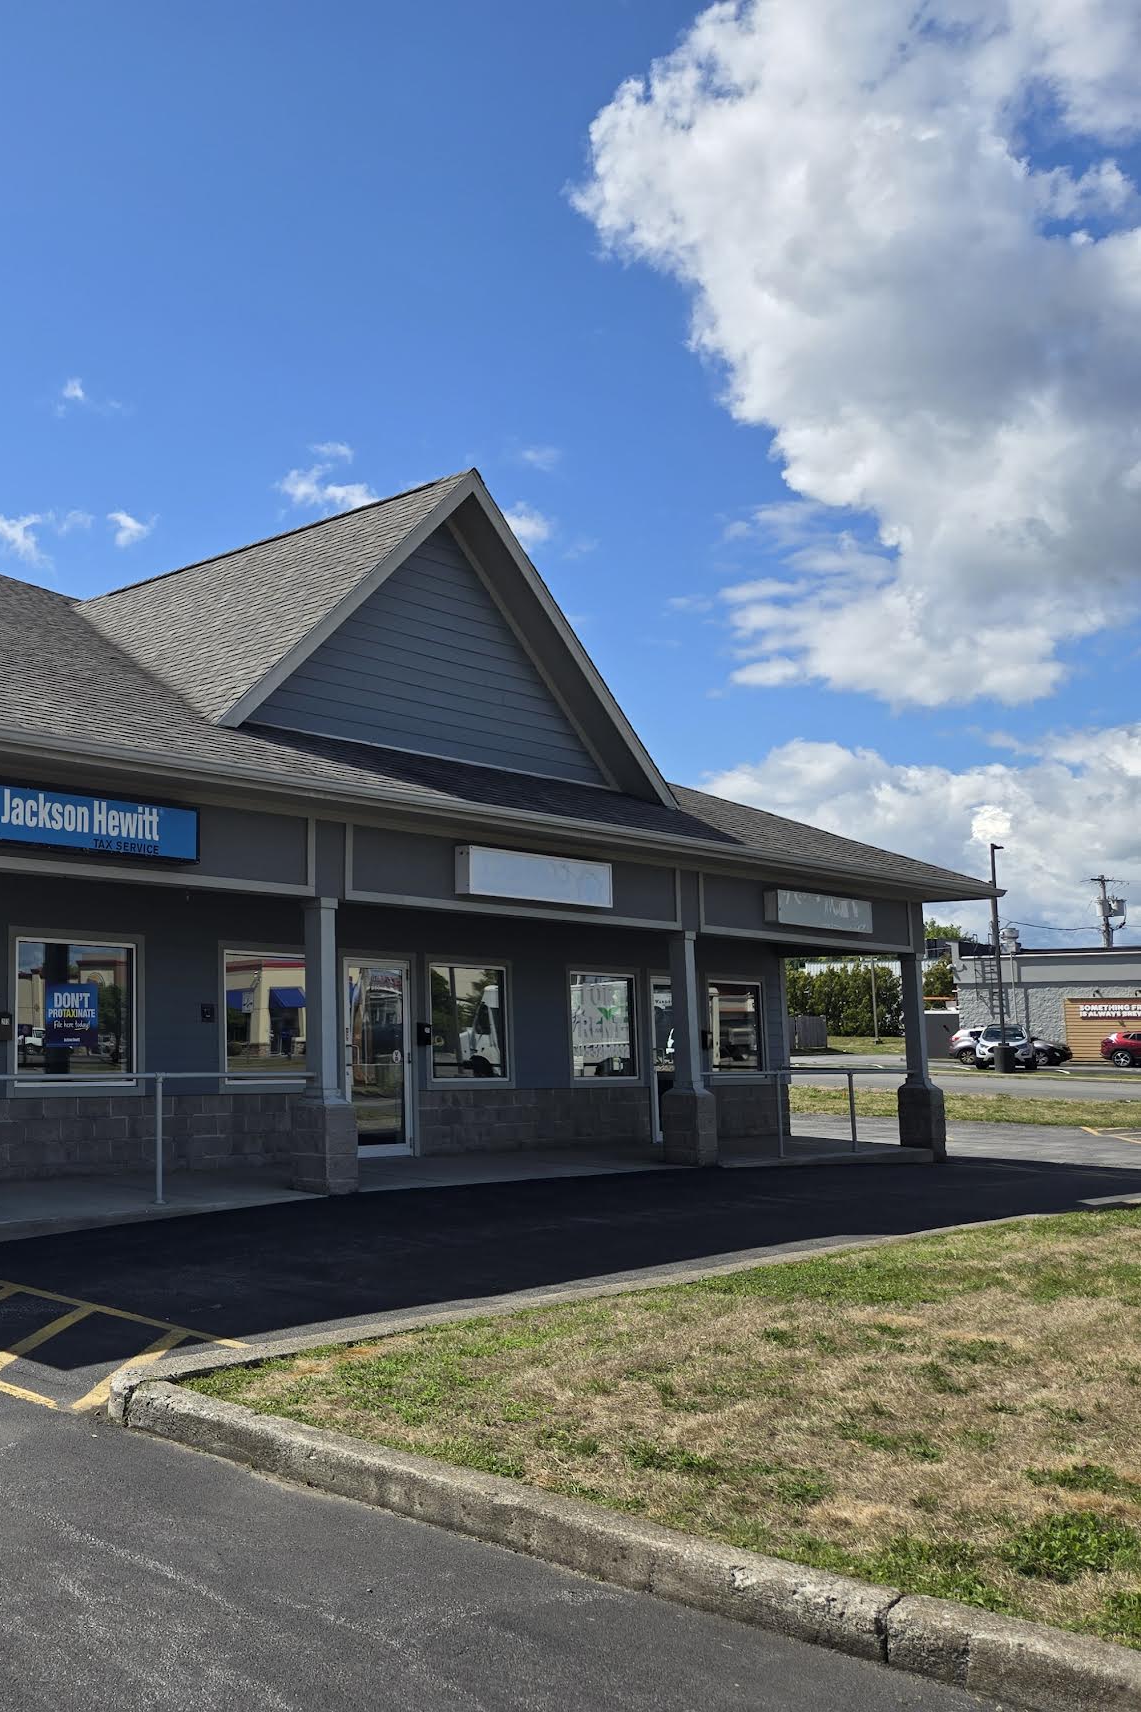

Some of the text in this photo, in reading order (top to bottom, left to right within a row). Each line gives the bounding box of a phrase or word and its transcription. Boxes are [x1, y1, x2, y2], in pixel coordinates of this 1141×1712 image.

[0, 788, 160, 841] Jackson Hewitt
[92, 838, 160, 855] TAX SERVICE
[53, 992, 91, 1008] DON'T
[48, 1009, 96, 1018] PROTAXINATE
[53, 1020, 63, 1029] File
[64, 1020, 74, 1028] here
